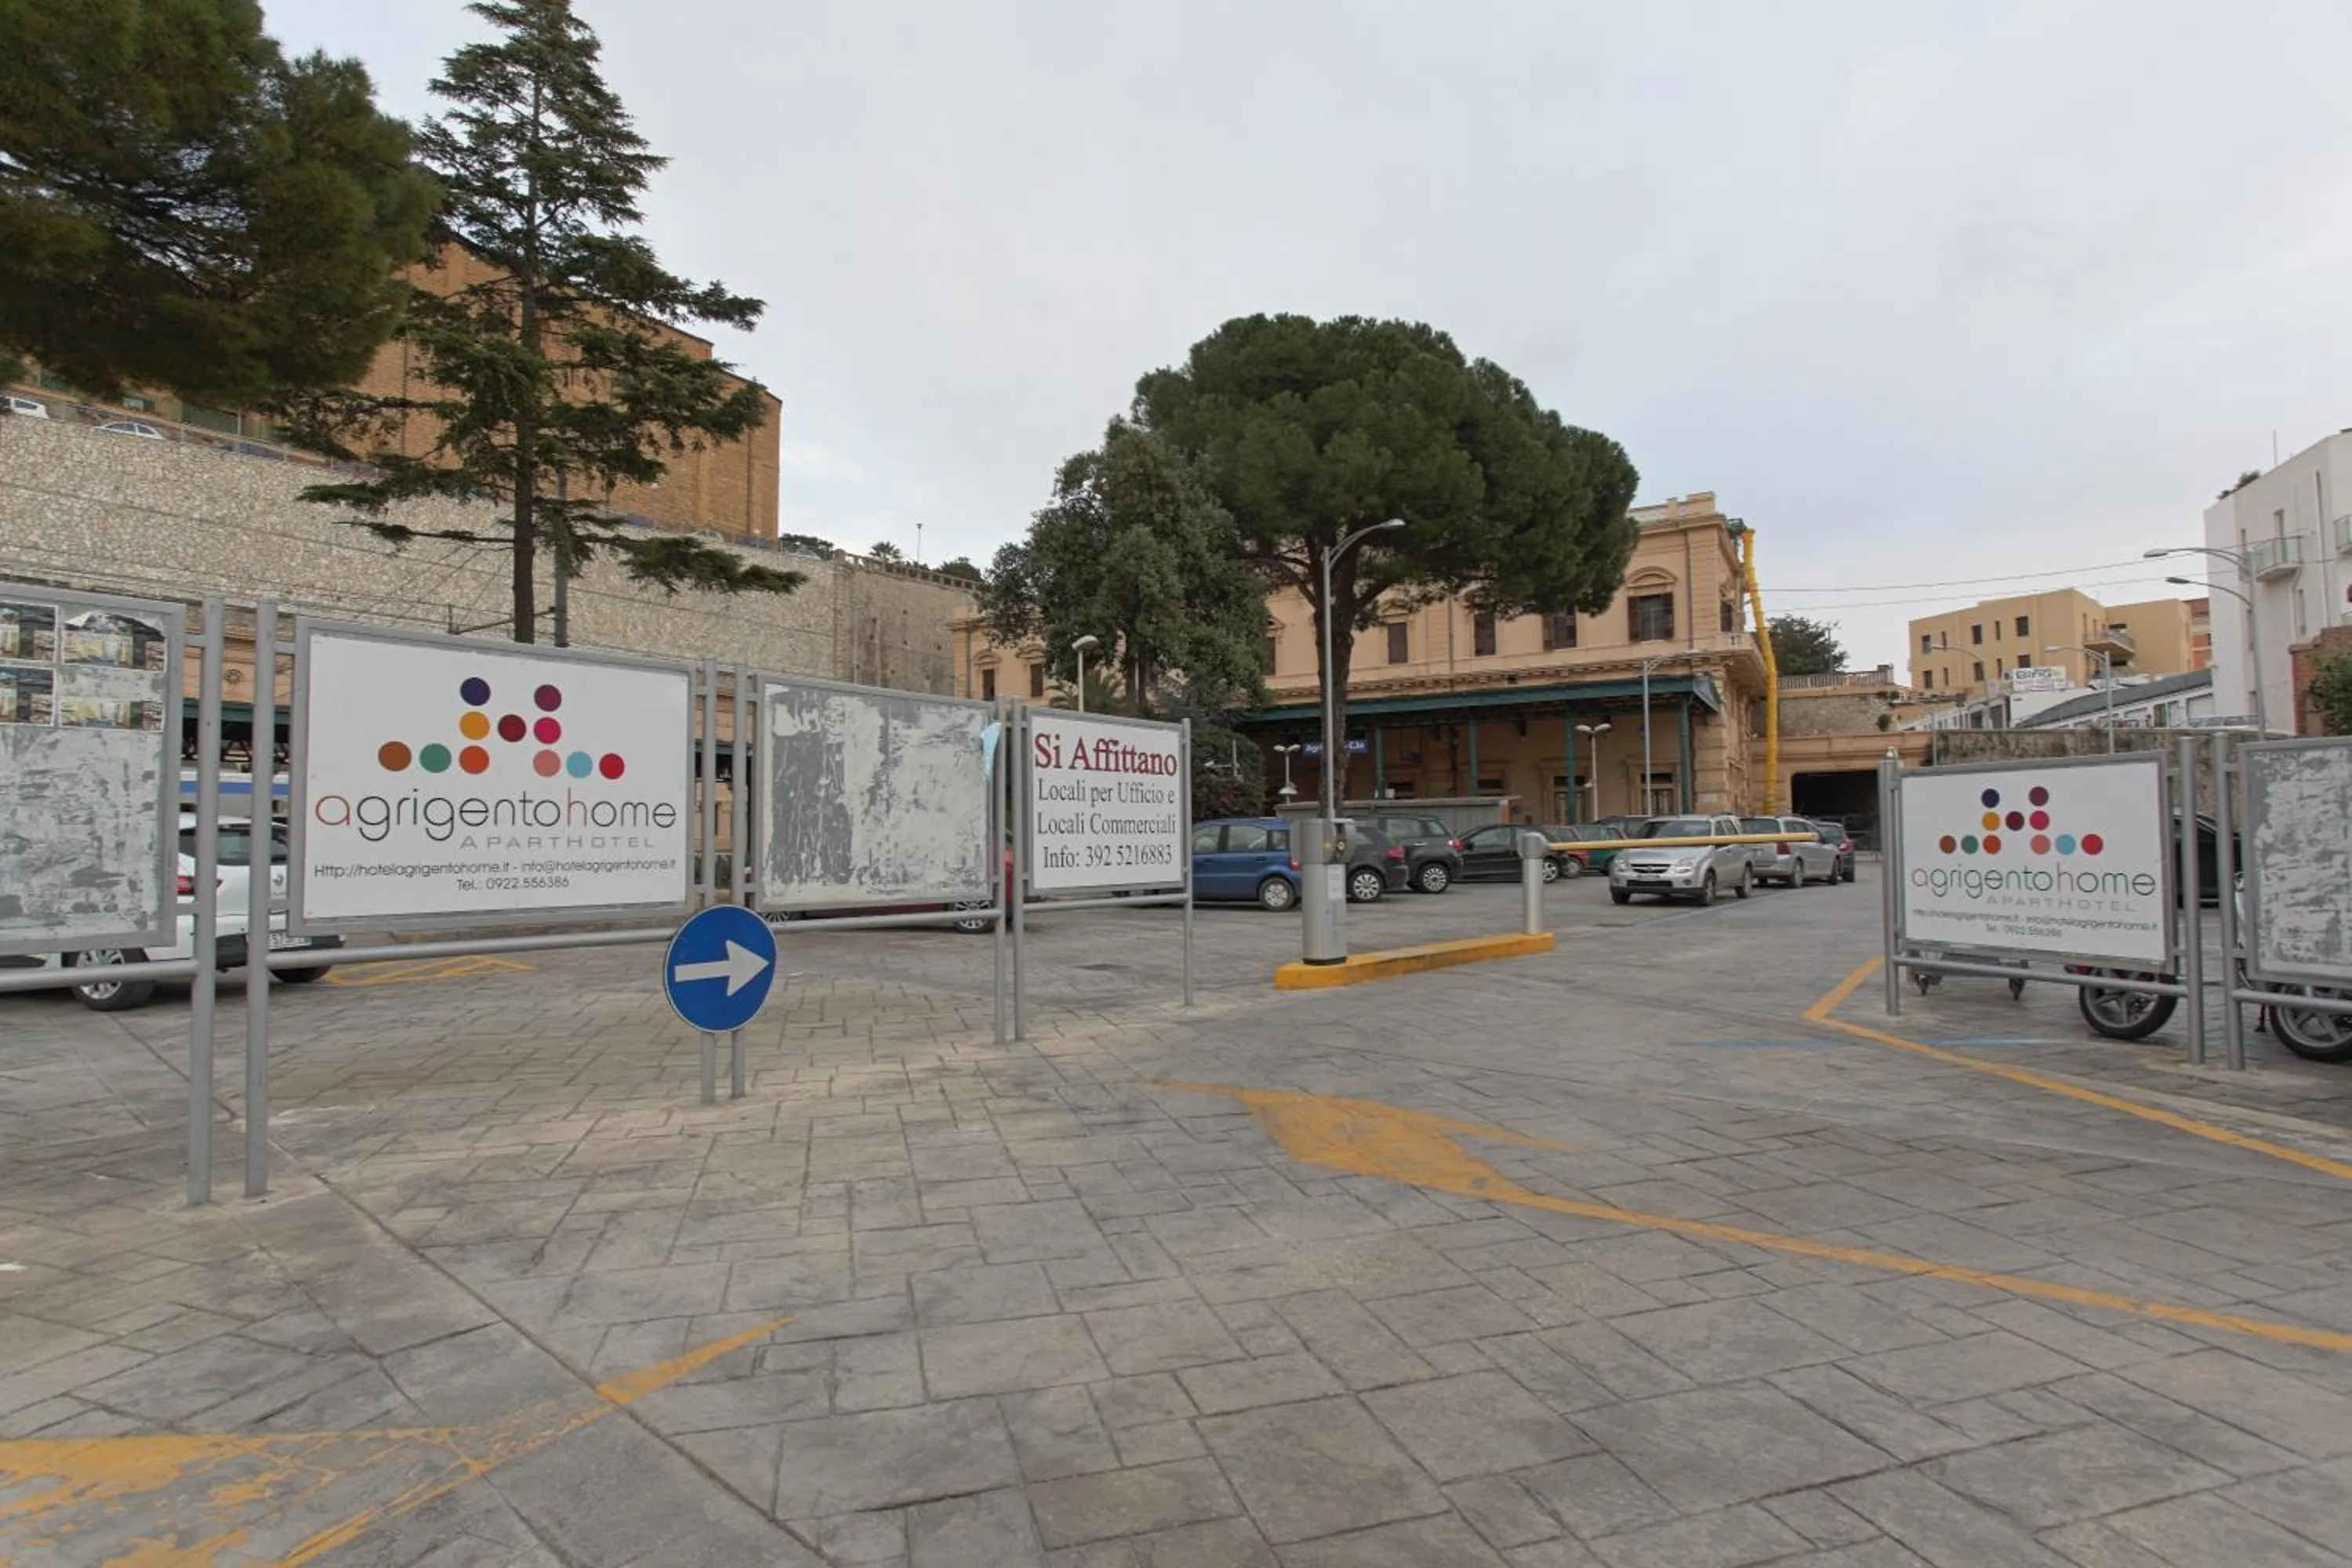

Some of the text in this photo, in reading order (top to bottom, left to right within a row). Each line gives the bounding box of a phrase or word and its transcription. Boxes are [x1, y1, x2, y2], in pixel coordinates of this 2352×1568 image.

[1034, 732, 1178, 776] Si Affittano
[1037, 778, 1175, 808] Locali per Ufficio e
[315, 787, 677, 841] agrigentohome
[1036, 811, 1176, 835] Locali Commerciali
[459, 835, 655, 850] APARTHOTEL
[1043, 844, 1173, 869] Info: 392 5216883
[1911, 862, 2156, 899] agrigentohome
